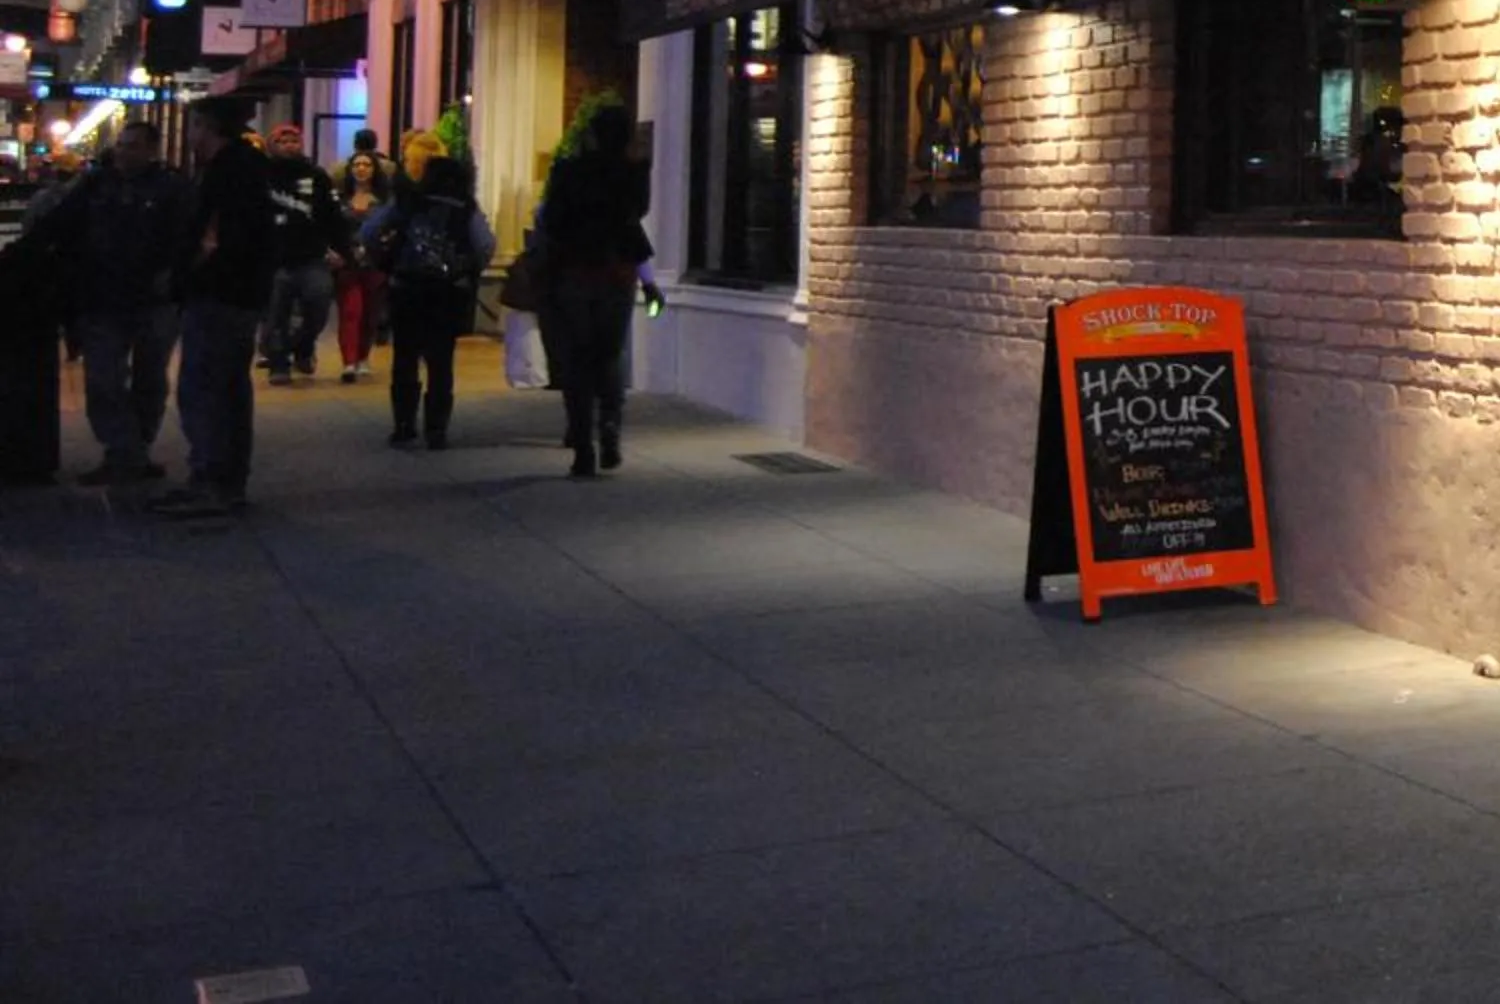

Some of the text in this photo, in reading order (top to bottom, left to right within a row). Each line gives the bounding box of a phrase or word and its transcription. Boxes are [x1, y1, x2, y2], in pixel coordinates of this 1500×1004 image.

[1082, 301, 1160, 331] SHOCK
[1169, 302, 1217, 324] TOP
[1081, 361, 1227, 397] HAPPY
[1084, 395, 1231, 436] HOUR
